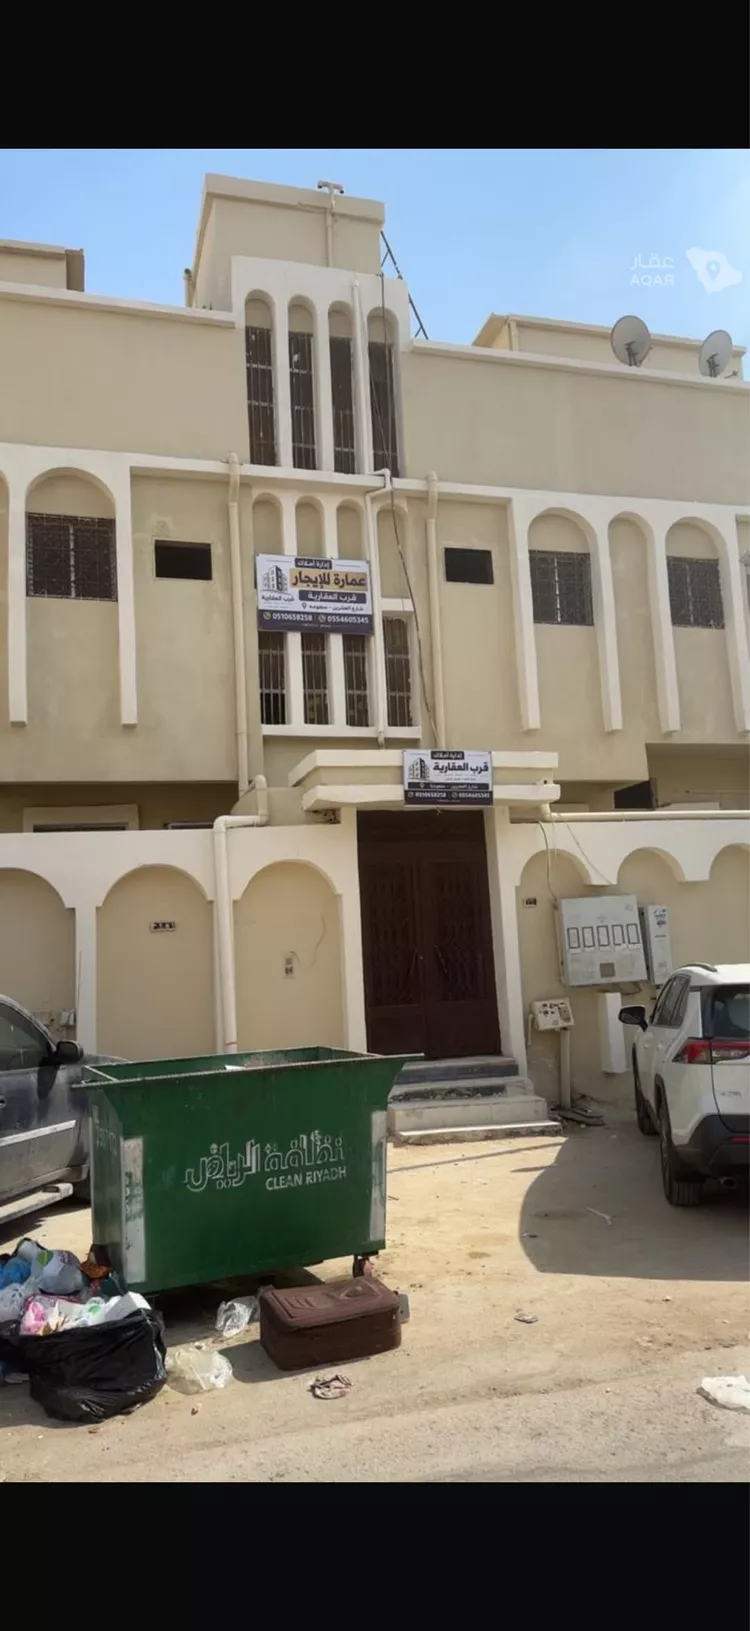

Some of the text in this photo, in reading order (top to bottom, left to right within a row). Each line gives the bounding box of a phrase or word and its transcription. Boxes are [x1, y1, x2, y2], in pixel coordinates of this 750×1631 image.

[292, 570, 366, 589] عمارة للإيجار
[308, 591, 338, 601] العقارية
[327, 615, 369, 623] 0554605345
[433, 761, 489, 774] قرب العقارية
[183, 1129, 345, 1192] نظافة الرياض
[265, 1166, 347, 1191] CLEAN RIYADH
